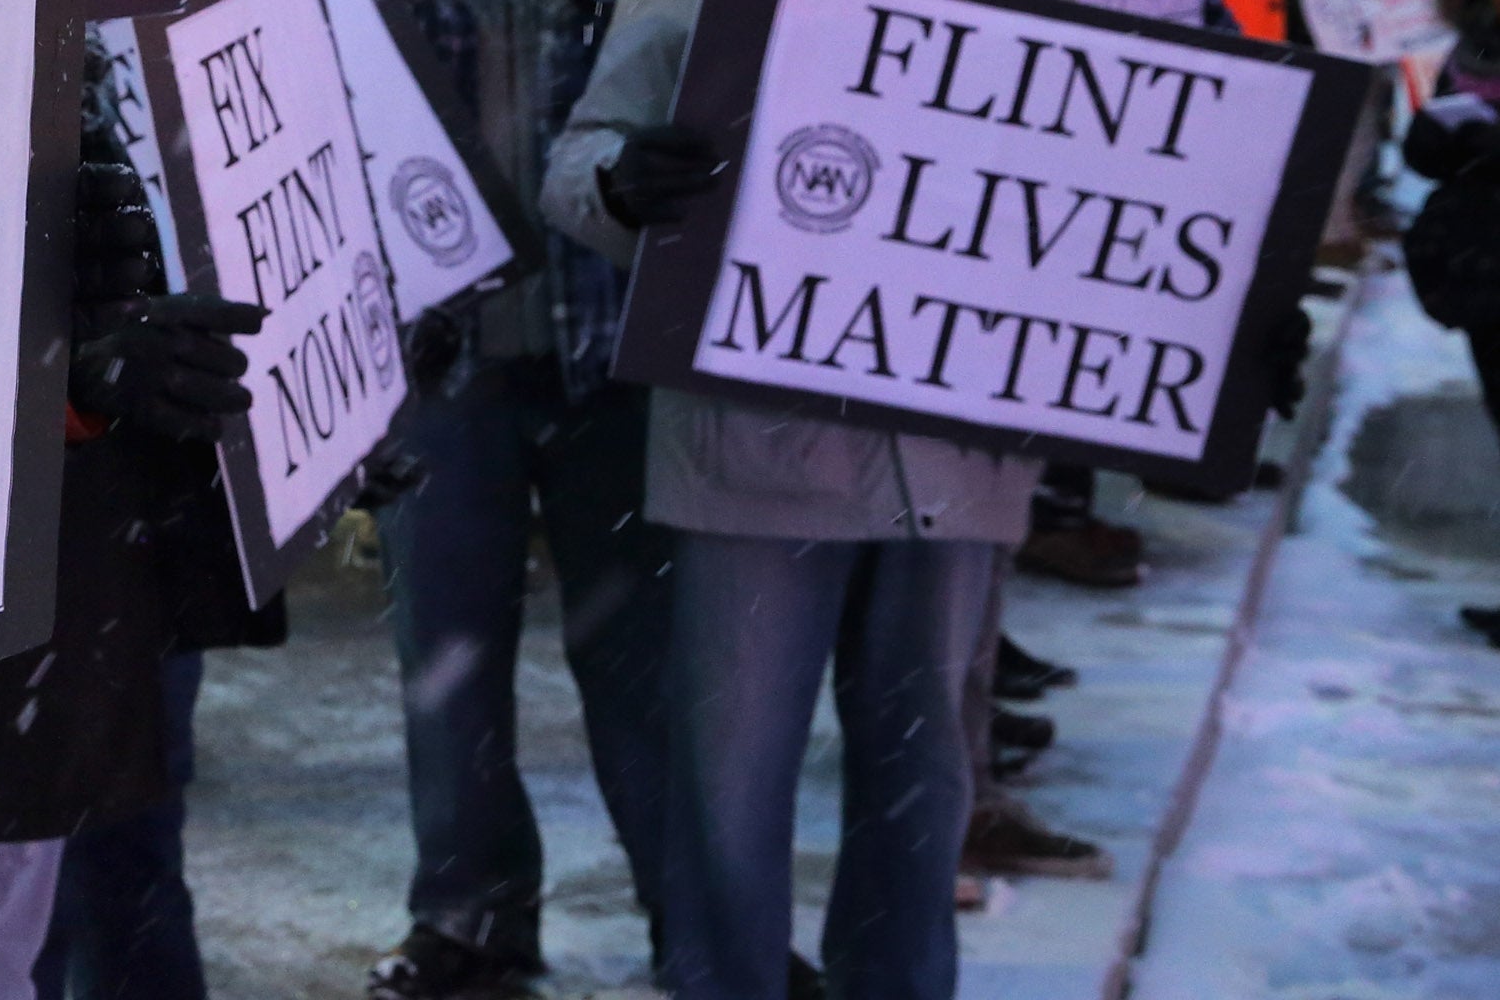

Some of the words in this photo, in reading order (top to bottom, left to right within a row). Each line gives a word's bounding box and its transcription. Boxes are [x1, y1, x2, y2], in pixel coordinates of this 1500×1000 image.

[200, 26, 283, 169] FIX
[845, 5, 1225, 161] FLINT
[236, 141, 347, 308] FLINT
[881, 155, 1236, 301] LIVES
[268, 294, 368, 479] NOW
[709, 260, 1207, 434] MATTER
